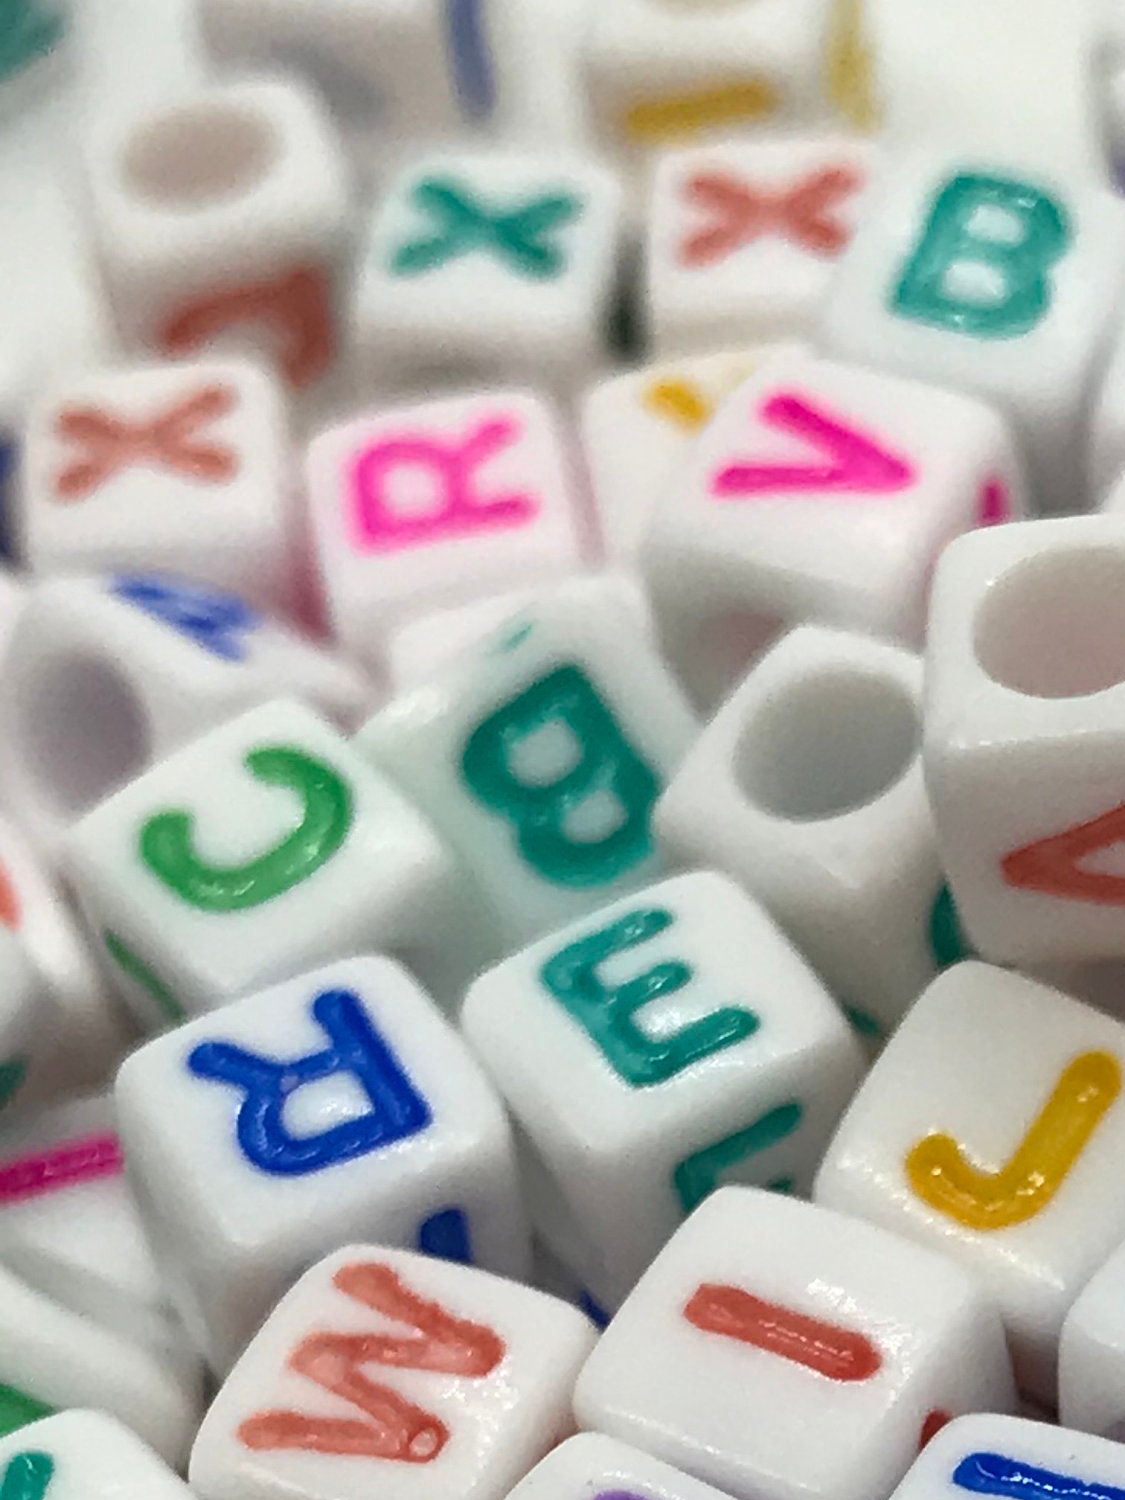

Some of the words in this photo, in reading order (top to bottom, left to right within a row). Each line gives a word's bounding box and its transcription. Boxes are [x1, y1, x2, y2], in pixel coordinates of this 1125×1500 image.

[391, 176, 577, 276] X
[681, 162, 863, 265] X
[889, 167, 1071, 339] B
[53, 384, 237, 500] X
[341, 409, 545, 557] R
[705, 386, 921, 502] V
[137, 744, 352, 912] C
[460, 664, 662, 890] B
[540, 908, 760, 1088] E
[185, 988, 433, 1177] R
[904, 1049, 1123, 1231] J
[237, 1263, 506, 1464] W
[684, 1283, 882, 1382] I
